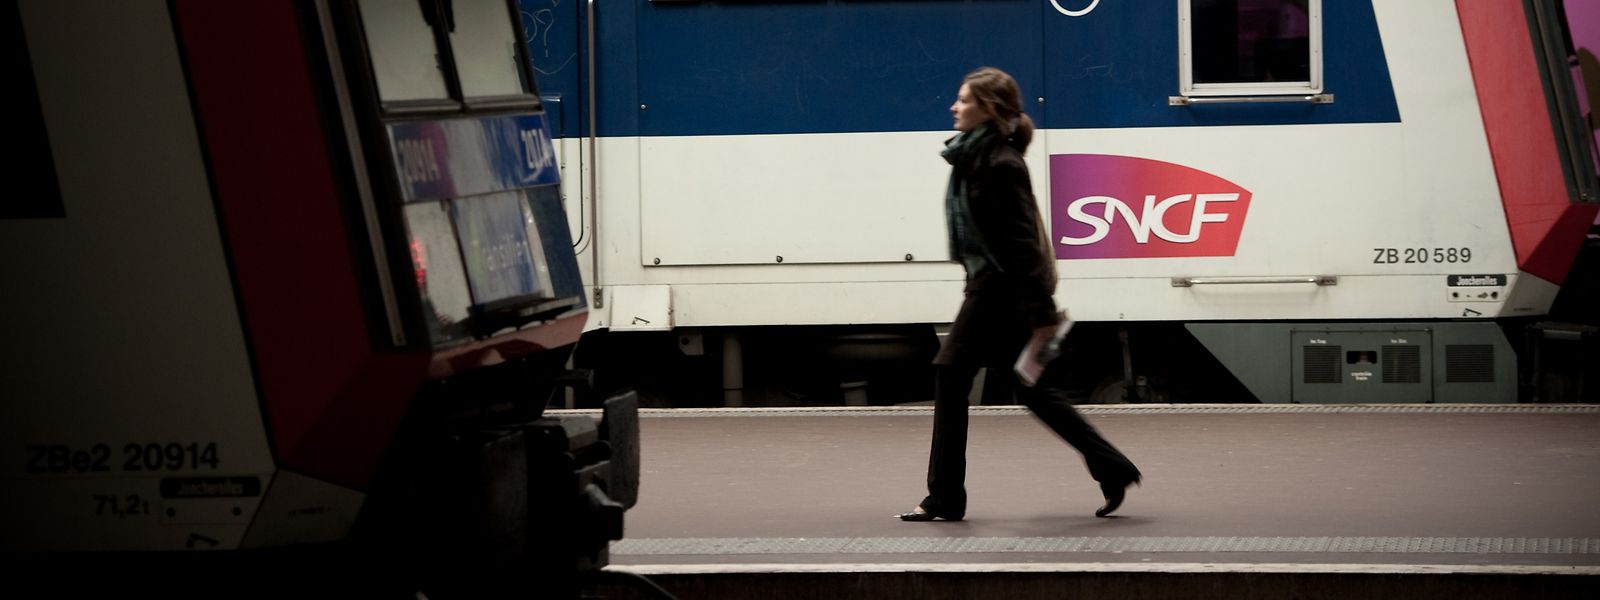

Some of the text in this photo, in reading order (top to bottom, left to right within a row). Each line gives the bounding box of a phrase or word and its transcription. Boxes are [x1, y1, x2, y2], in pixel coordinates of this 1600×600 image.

[1060, 192, 1240, 245] SNCF
[1373, 248, 1399, 264] ZB
[25, 442, 219, 473] ZBe2 20914
